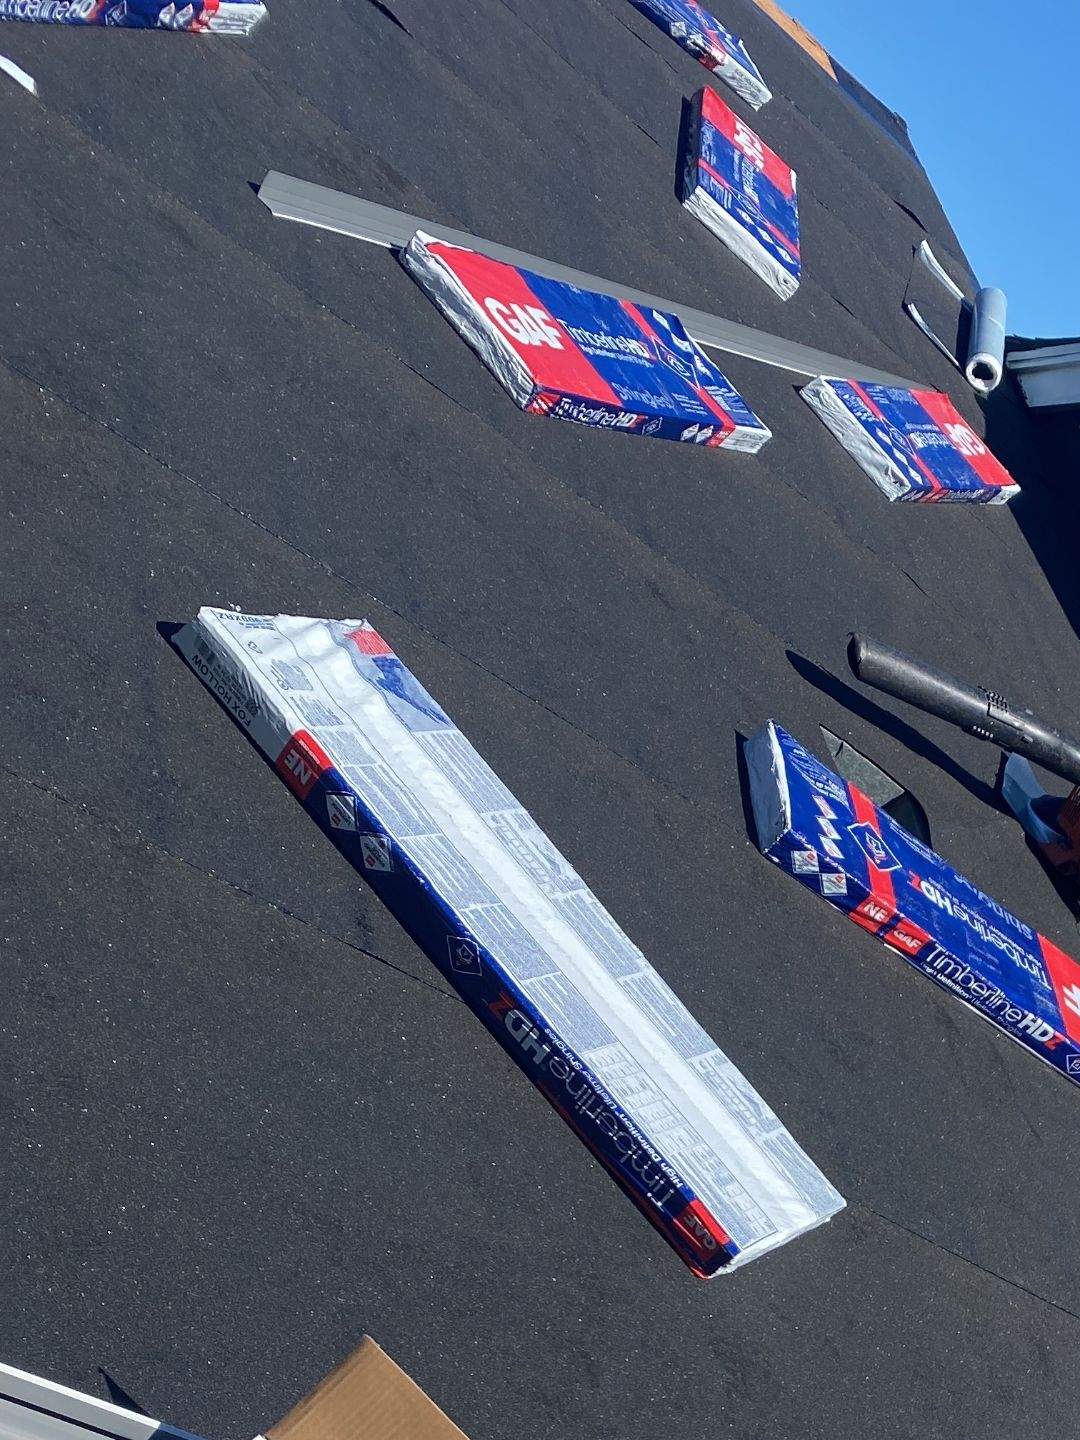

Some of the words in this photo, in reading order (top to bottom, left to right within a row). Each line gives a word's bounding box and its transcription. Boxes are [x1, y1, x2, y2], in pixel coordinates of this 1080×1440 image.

[484, 297, 564, 350] GAF
[190, 654, 233, 704] HOLLOW
[229, 701, 253, 726] FOX
[282, 748, 312, 784] NE
[862, 900, 888, 923] NE
[891, 927, 921, 951] GAF
[542, 1025, 583, 1071] Shingles
[579, 1066, 617, 1110] Lifetime
[659, 1160, 684, 1188] High
[682, 1211, 718, 1251] GAF
